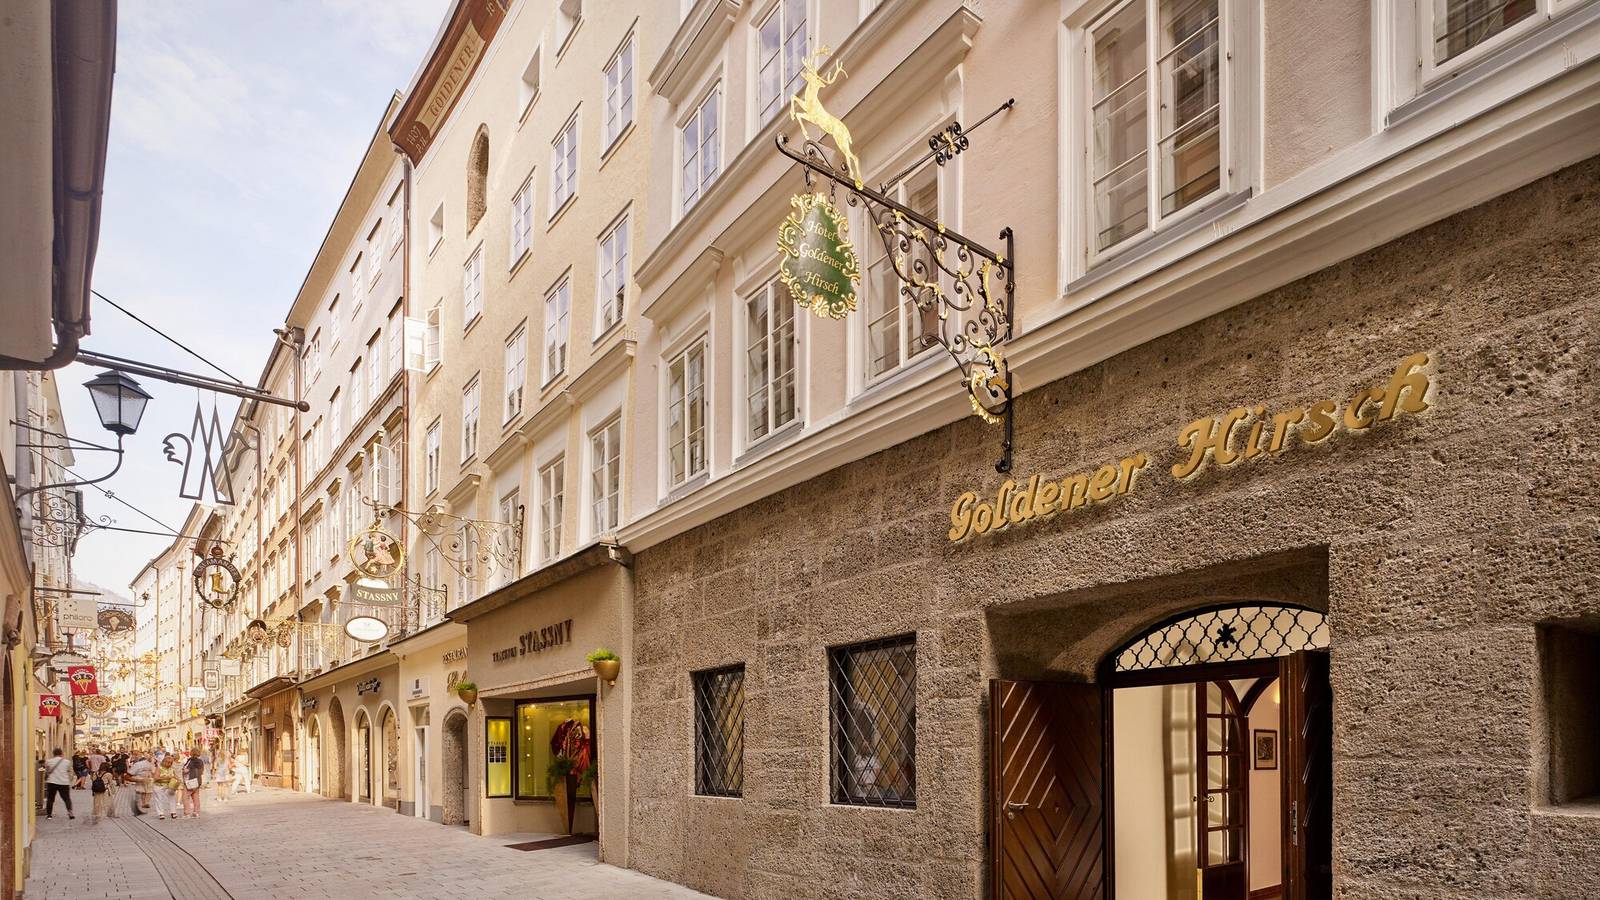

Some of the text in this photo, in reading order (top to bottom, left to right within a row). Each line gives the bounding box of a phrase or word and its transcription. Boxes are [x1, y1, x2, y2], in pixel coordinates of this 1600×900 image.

[430, 47, 475, 117] GOLDENER
[807, 221, 837, 242] Hotel
[799, 243, 843, 270] Goldener
[804, 271, 839, 295] Hirsch
[948, 352, 1431, 542] Goldener Hirsch
[356, 589, 399, 602] STASSNY
[63, 613, 93, 622] philoro
[519, 618, 573, 656] STASSNY
